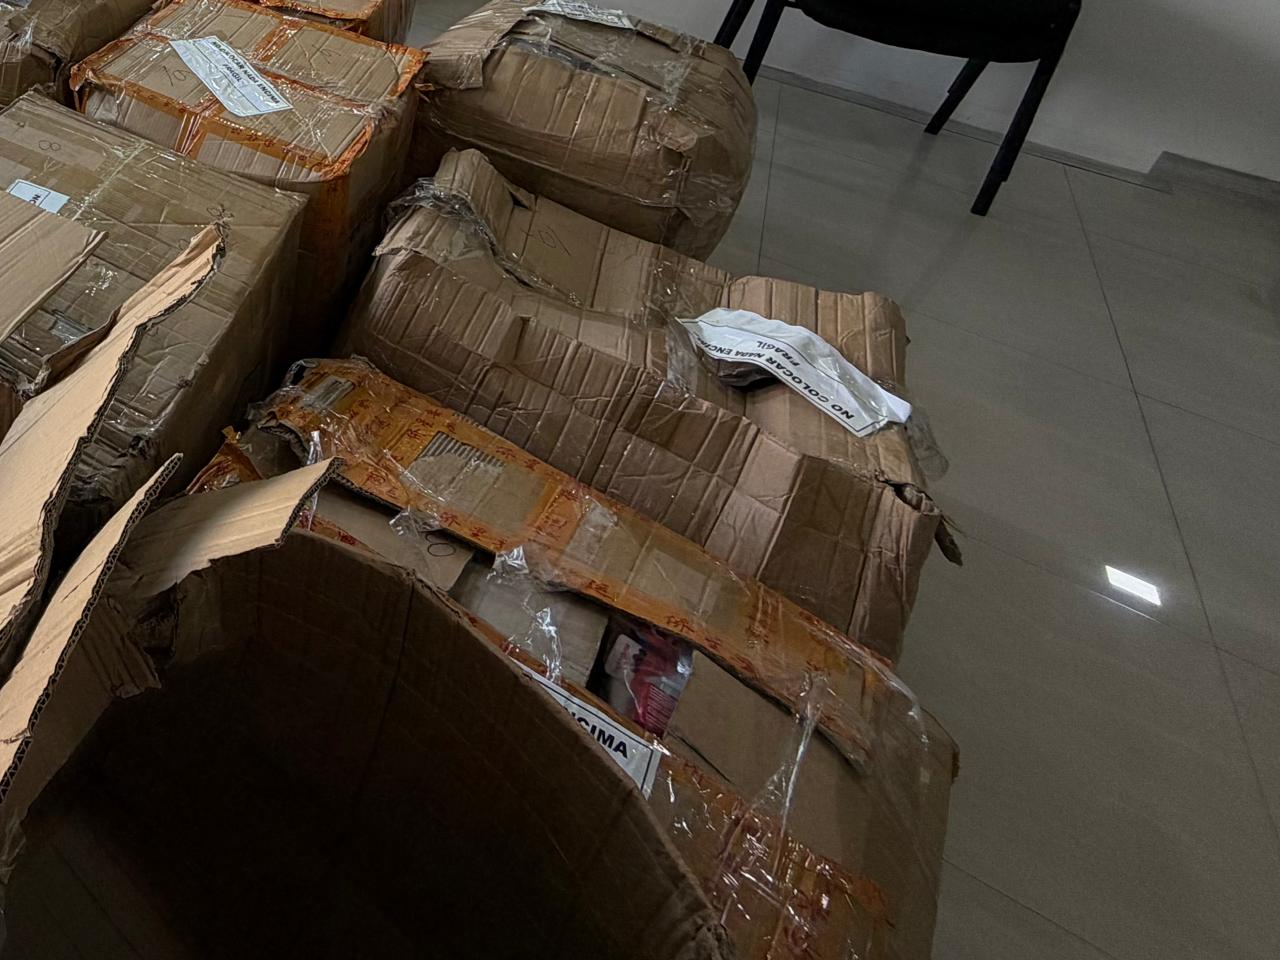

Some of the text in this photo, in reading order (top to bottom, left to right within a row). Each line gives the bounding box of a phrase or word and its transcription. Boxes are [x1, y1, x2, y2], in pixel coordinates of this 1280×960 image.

[756, 340, 801, 367] FRAGIL
[696, 337, 856, 421] NO COLOCAR NADA ENCIM
[575, 714, 629, 760] CIMA
